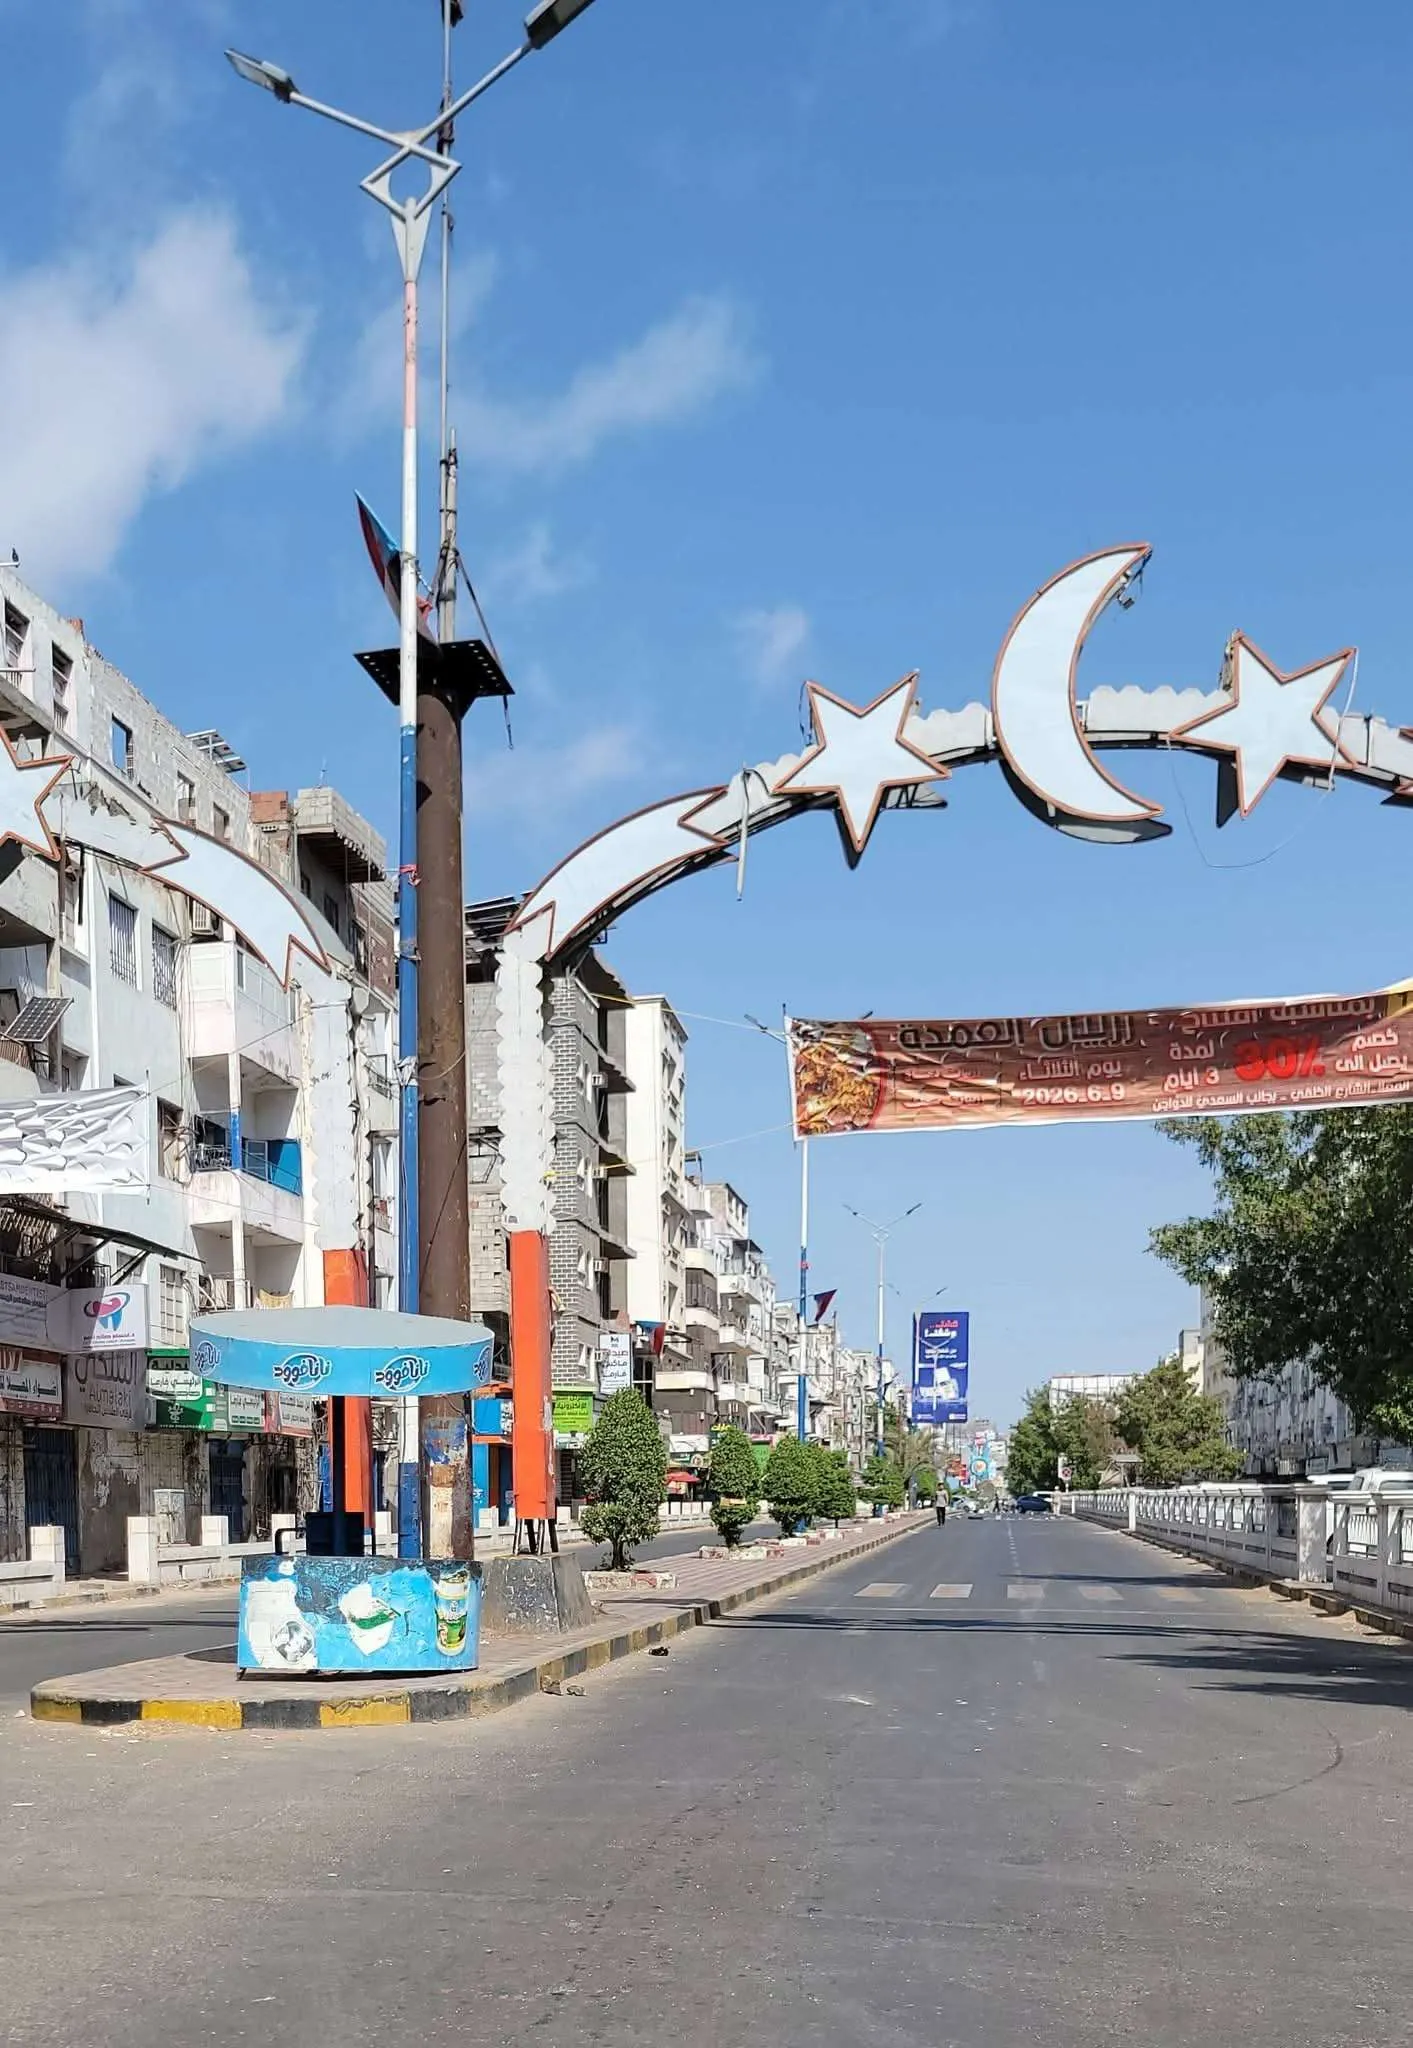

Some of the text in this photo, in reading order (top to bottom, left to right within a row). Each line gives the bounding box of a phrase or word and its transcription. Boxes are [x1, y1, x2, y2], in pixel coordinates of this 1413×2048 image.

[897, 1019, 1025, 1052] العمدة
[1351, 1027, 1399, 1052] خصم
[1169, 1039, 1215, 1061] لمدة
[1019, 1060, 1123, 1081] يوم الثلاثاء
[1206, 1066, 1220, 1085] 3
[1291, 1084, 1332, 1101] الخلفي
[152, 1360, 189, 1373] يدلية
